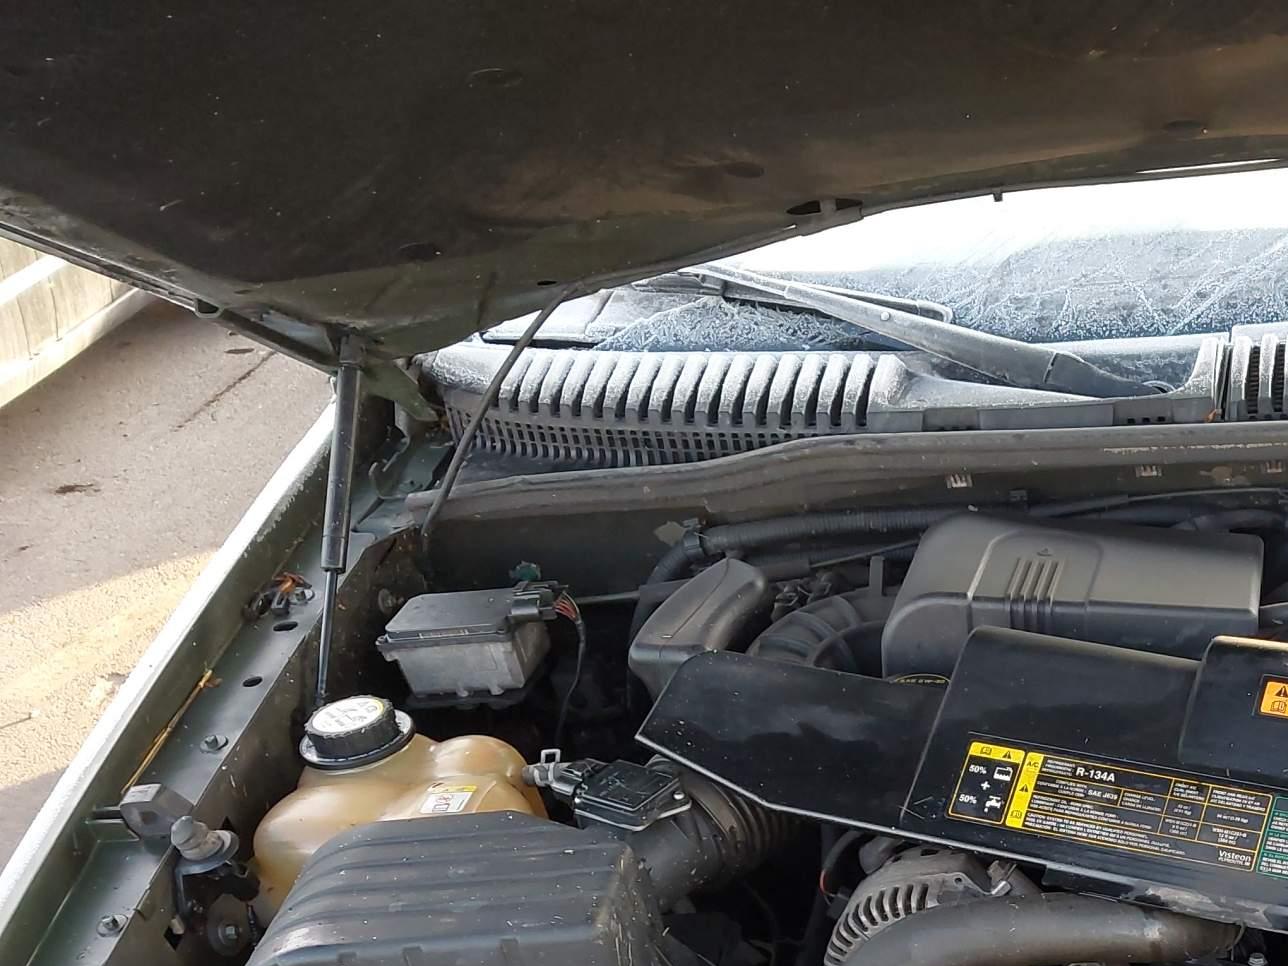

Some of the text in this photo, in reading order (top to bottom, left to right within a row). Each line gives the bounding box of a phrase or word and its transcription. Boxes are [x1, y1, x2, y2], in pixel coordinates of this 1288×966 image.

[968, 764, 987, 775] 50%
[1027, 760, 1039, 769] A/C
[1076, 766, 1116, 782] R-134A
[958, 793, 977, 804] 50%
[1219, 850, 1251, 861] Visteon
